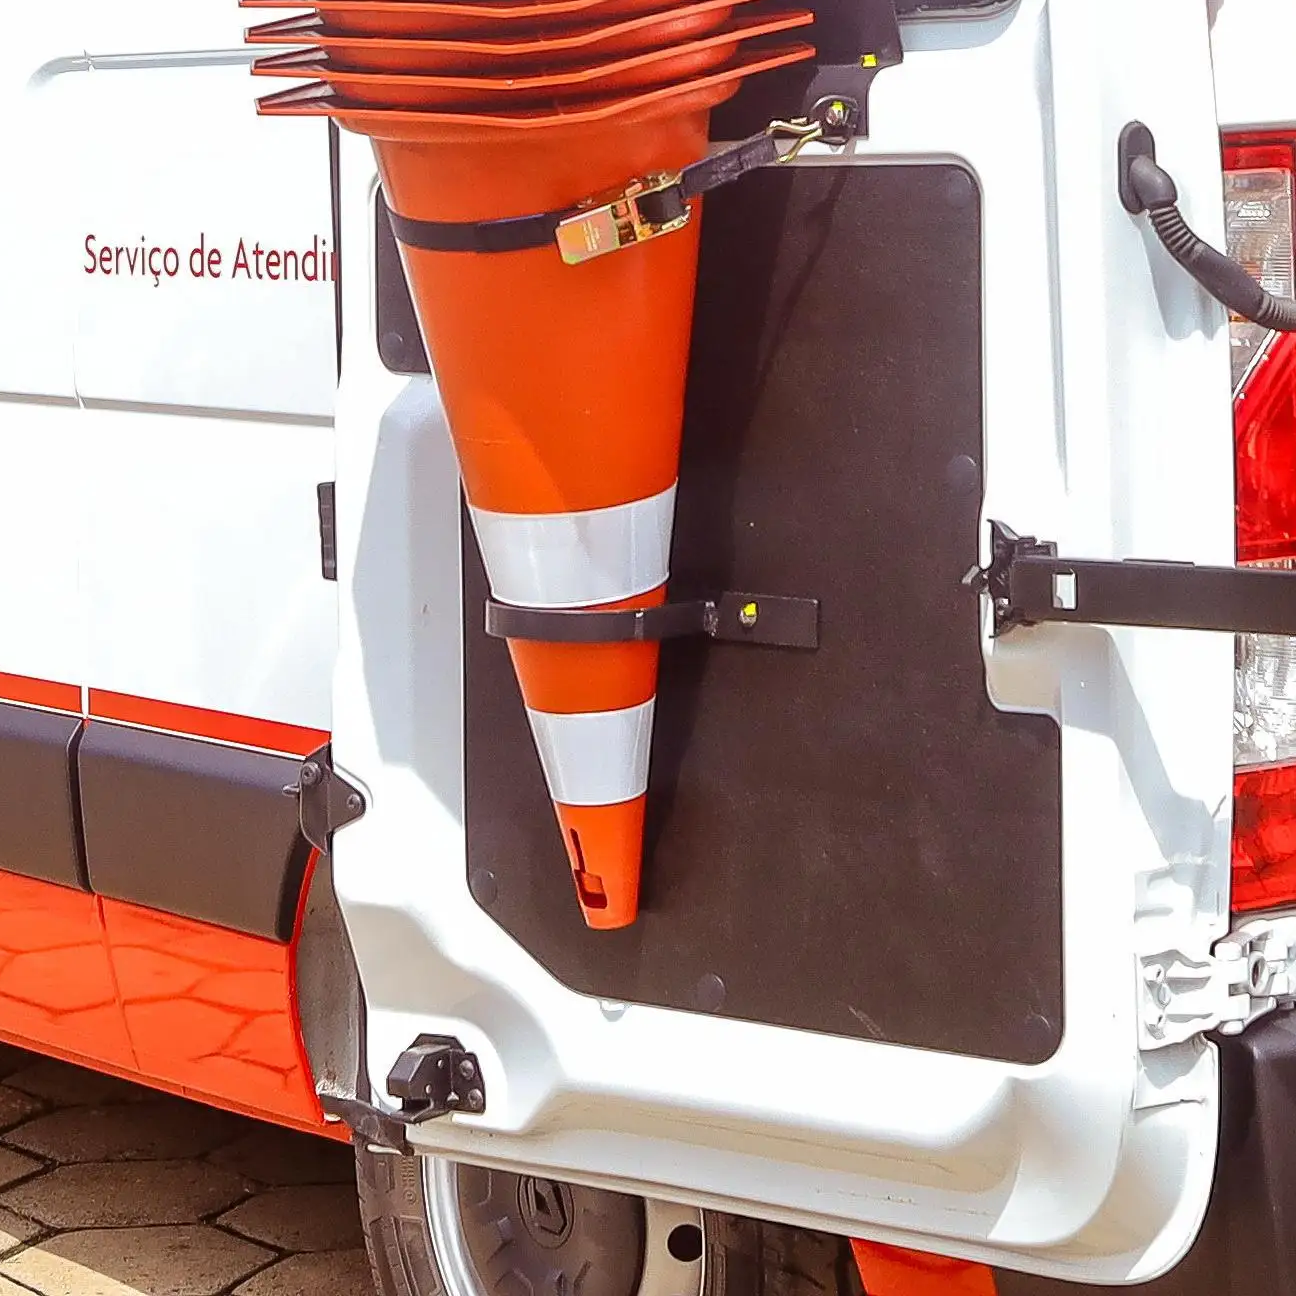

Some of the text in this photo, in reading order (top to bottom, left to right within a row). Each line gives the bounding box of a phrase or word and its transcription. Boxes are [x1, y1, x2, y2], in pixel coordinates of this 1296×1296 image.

[84, 232, 337, 288] Serviço de Atendi
